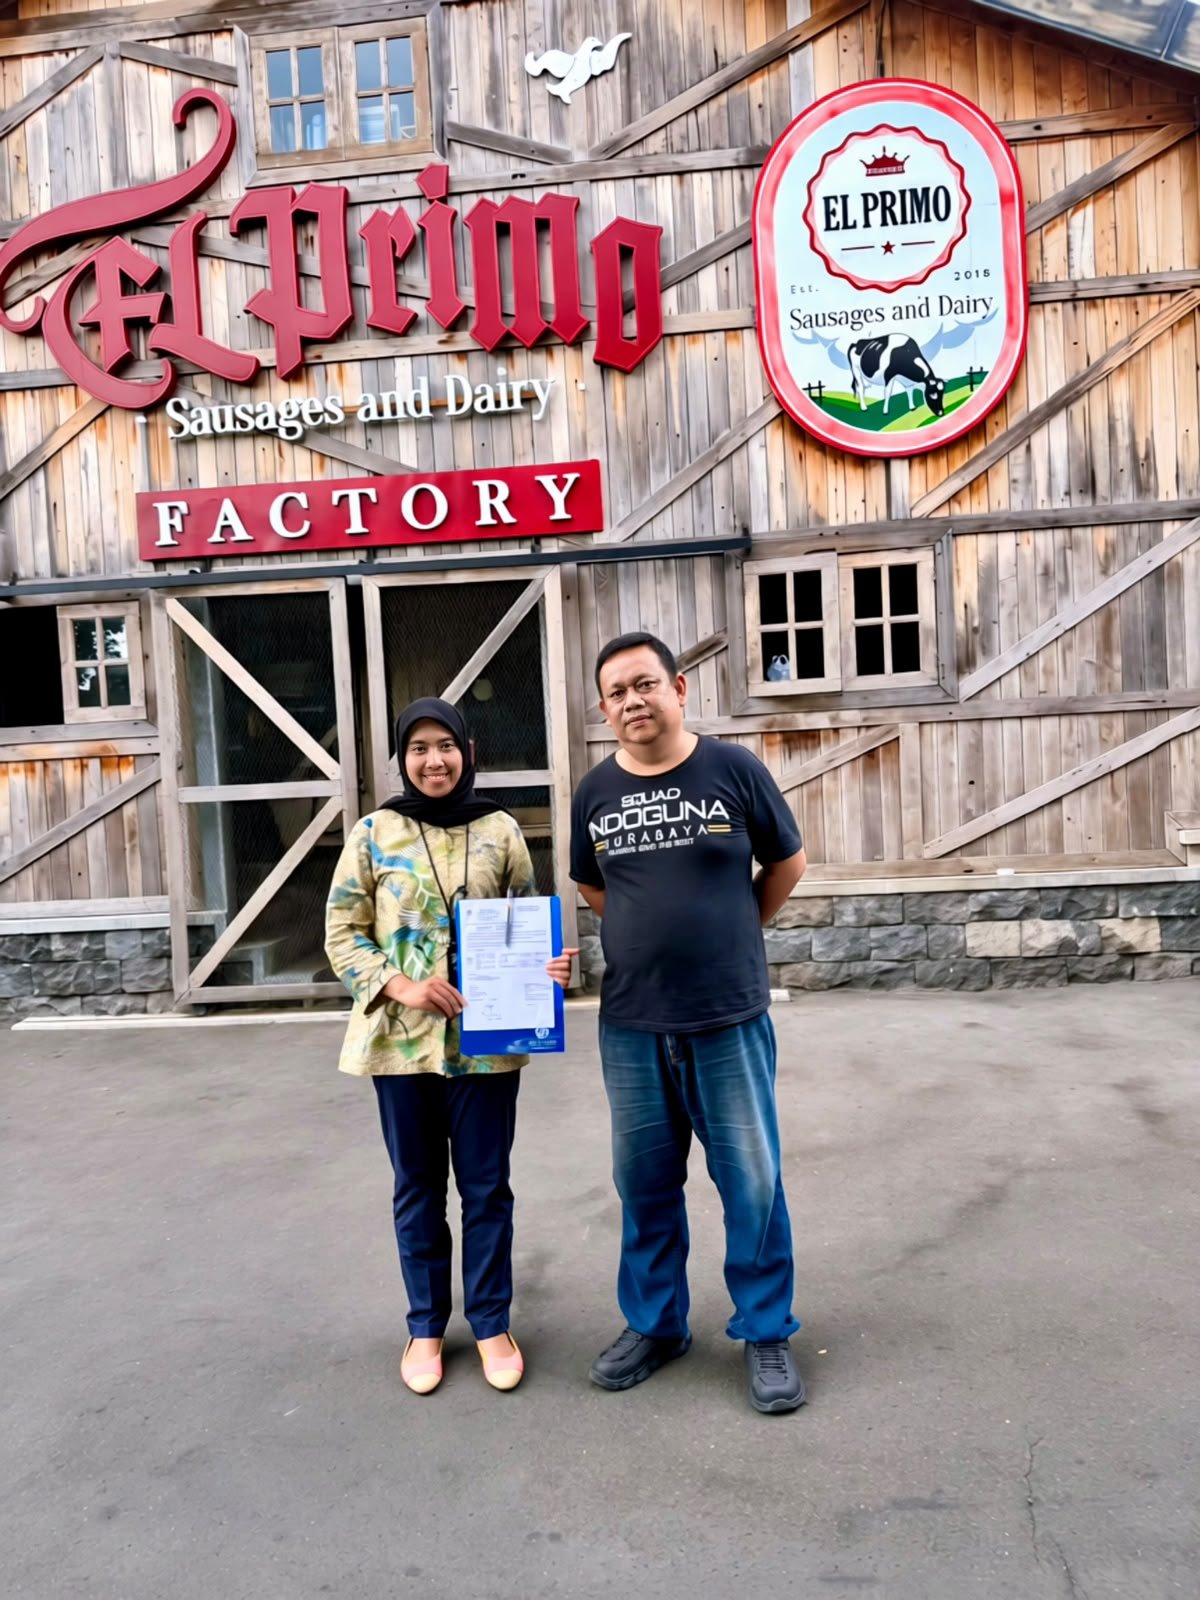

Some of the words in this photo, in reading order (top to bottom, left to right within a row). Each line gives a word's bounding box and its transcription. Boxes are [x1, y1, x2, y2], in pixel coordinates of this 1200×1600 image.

[822, 194, 857, 232] EL
[860, 185, 952, 229] PRIMO
[789, 305, 886, 332] Sausages
[891, 295, 930, 321] and
[937, 294, 994, 320] Dairy
[165, 392, 345, 441] Sausages
[356, 376, 434, 422] and
[443, 367, 556, 421] Dairy
[153, 471, 581, 548] FACTORY
[621, 787, 681, 808] SQUAD
